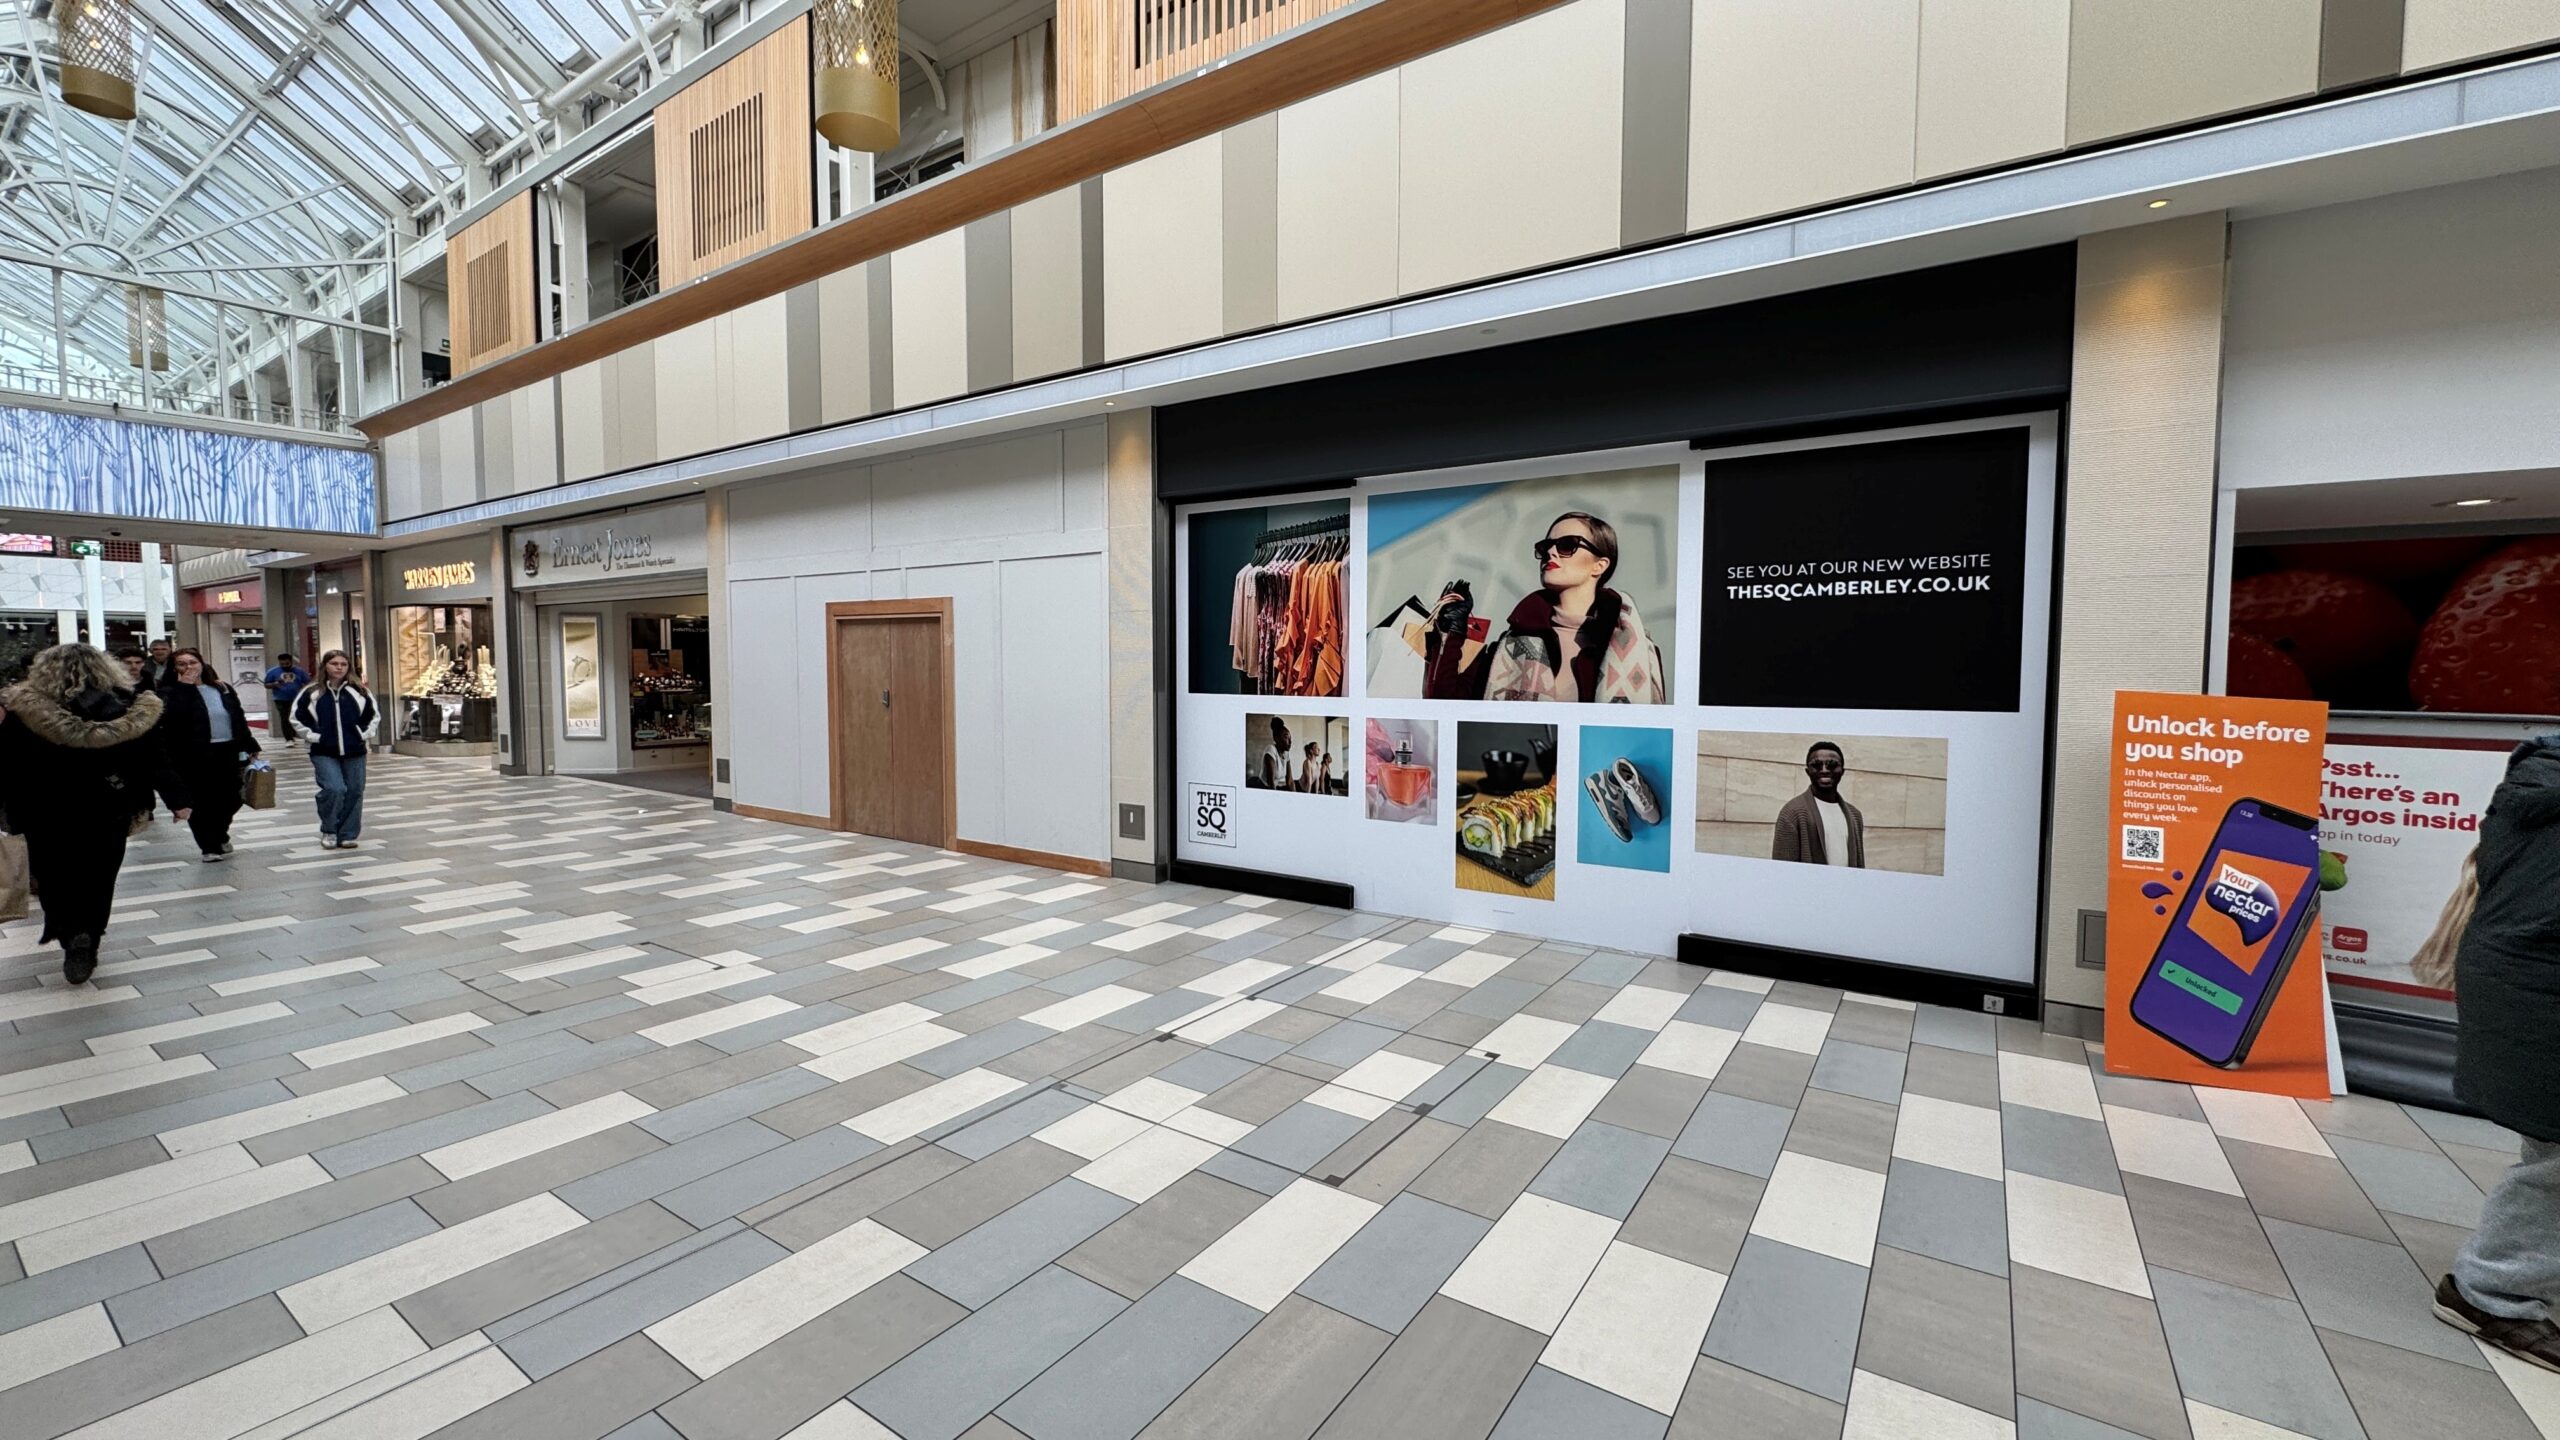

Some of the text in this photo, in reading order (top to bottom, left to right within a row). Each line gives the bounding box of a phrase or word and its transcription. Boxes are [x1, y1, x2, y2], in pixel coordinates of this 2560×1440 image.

[552, 528, 652, 572] Ernest Jones
[443, 561, 475, 589] JAMES
[1727, 553, 1991, 579] SEE YOU AT OUR NEW WEBSITE
[1727, 575, 1991, 601] THESQCAMBERLEY.CO.UK
[568, 719, 599, 728] LOVE
[2127, 714, 2310, 744] Unlock before
[2125, 741, 2243, 768] you shop
[2124, 768, 2135, 776] In
[2137, 768, 2154, 778] the
[2155, 770, 2187, 781] Nectar
[2123, 788, 2186, 801] discounts on
[2124, 779, 2223, 793] unlock personalised
[1197, 791, 1227, 807] THE
[2123, 799, 2198, 813] things you love
[2422, 790, 2460, 807] an
[1197, 806, 1226, 833] SQ
[2123, 811, 2181, 823] every week.
[2402, 808, 2480, 832] insid
[1197, 830, 1227, 839] CAMBERLEY
[2318, 830, 2400, 847] op in today
[2224, 869, 2254, 889] Your
[2213, 885, 2274, 916] nectar
[2228, 905, 2260, 923] prices
[2336, 933, 2362, 943] Argos
[2185, 977, 2217, 997] Unlocked
